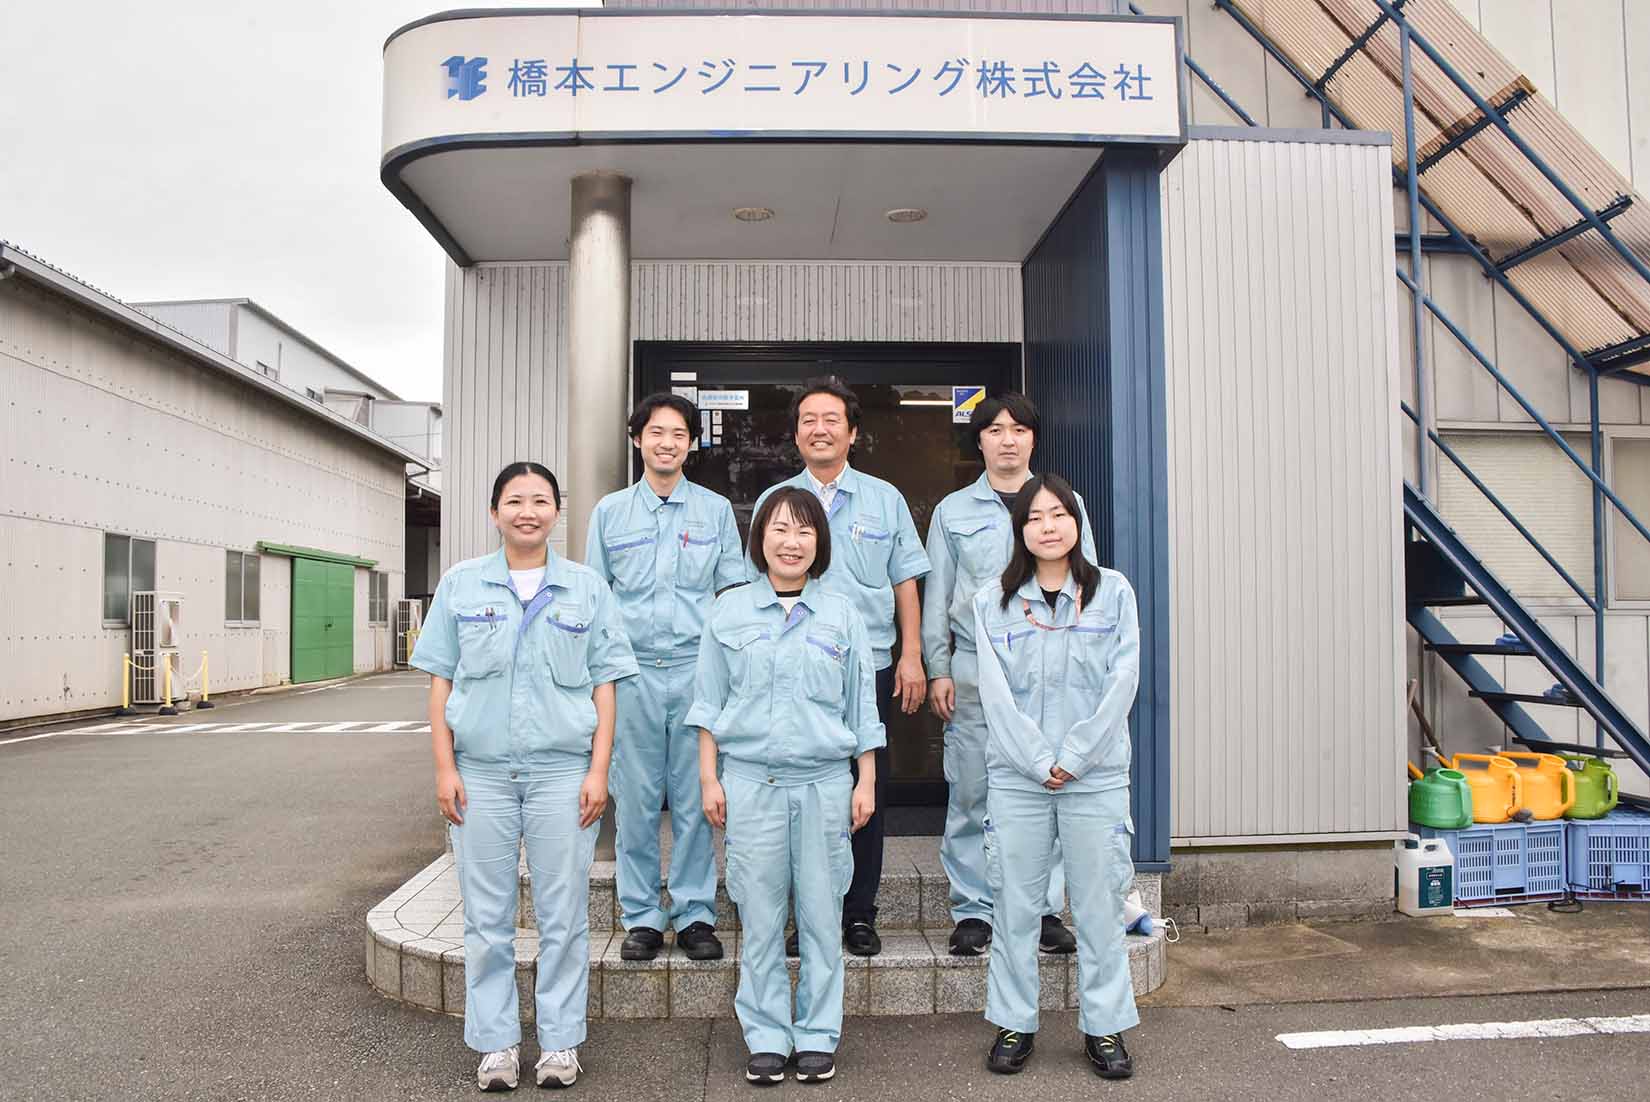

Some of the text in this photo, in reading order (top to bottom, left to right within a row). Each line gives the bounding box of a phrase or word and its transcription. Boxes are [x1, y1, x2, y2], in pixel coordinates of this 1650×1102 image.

[508, 59, 1154, 101] 橋本エンジニアリング株式会社
